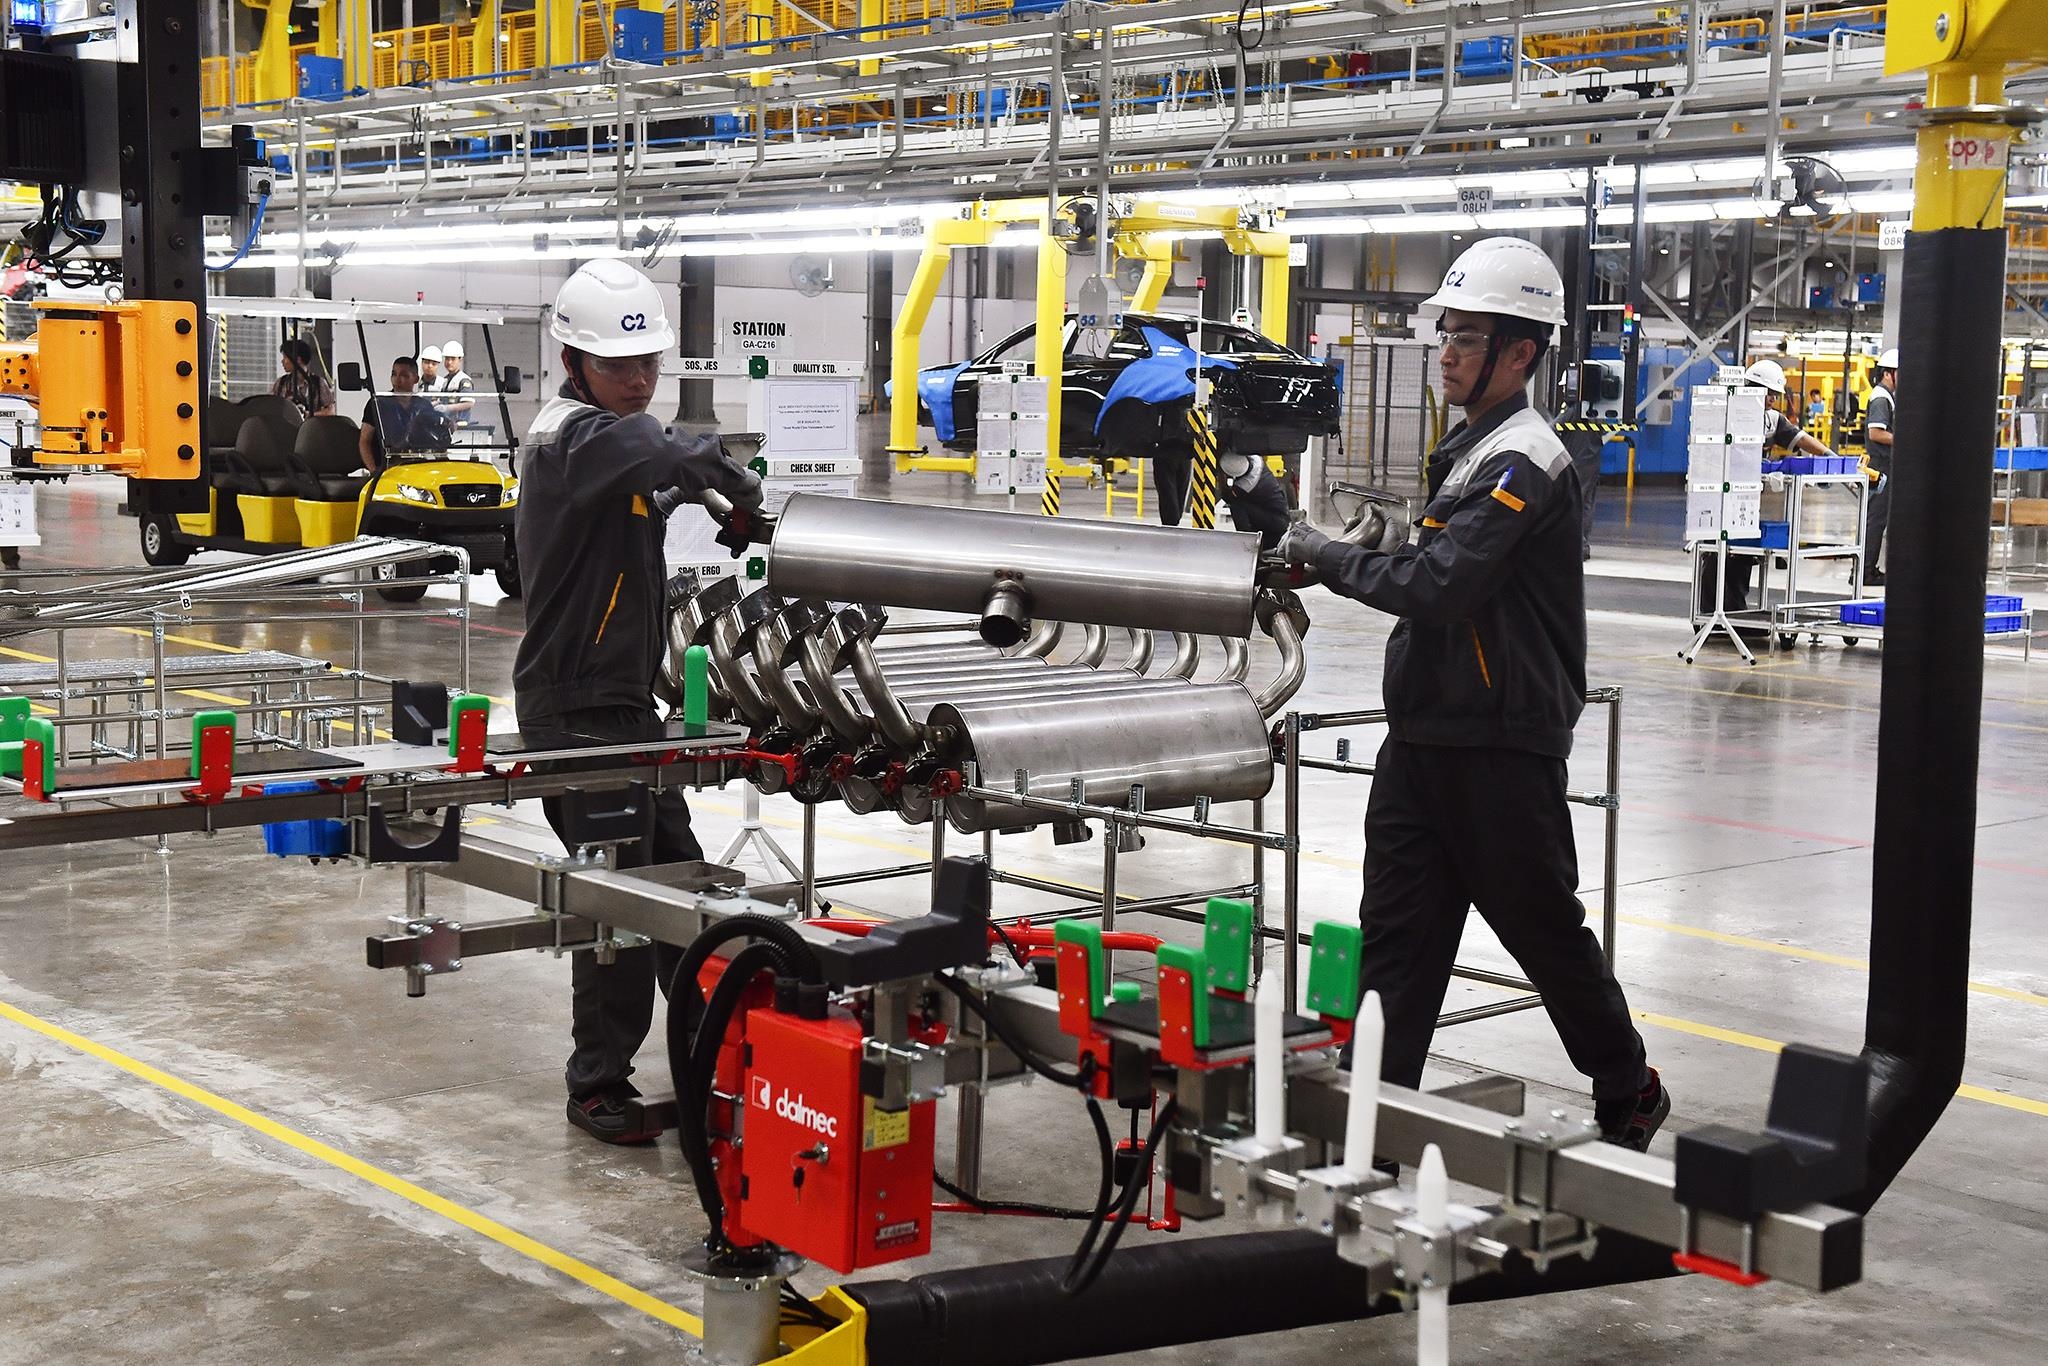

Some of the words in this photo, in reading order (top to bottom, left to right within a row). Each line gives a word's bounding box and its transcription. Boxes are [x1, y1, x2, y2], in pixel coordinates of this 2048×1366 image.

[1461, 190, 1490, 201] GA-C1
[1463, 202, 1487, 213] 08LH
[1446, 271, 1466, 287] C2
[621, 312, 647, 331] C2
[732, 321, 786, 337] STATION
[742, 340, 776, 349] GA-C216
[685, 361, 702, 371] SOS,
[704, 361, 718, 371] JES
[792, 363, 820, 374] QUALITY
[822, 364, 837, 374] STD.
[790, 463, 813, 473] CHECK
[814, 463, 836, 473] SHEET
[701, 565, 721, 575] ERGO
[183, 598, 191, 608] B
[775, 1088, 838, 1139] dalmec
